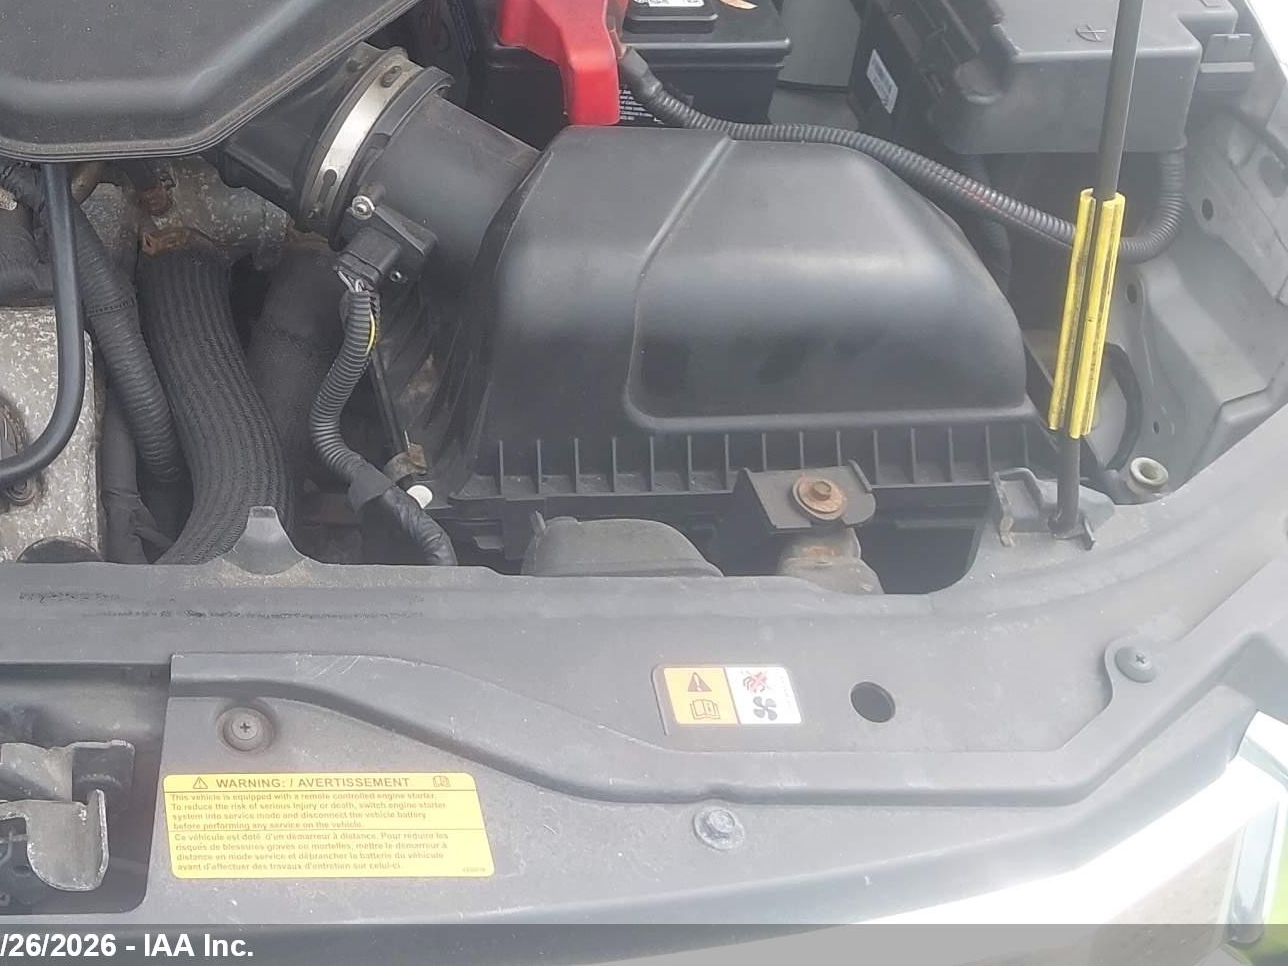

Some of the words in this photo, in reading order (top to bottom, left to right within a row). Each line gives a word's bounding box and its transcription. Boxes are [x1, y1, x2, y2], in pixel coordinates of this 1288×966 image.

[216, 778, 286, 789] WARNING:
[298, 777, 410, 788] AVERTISSEMENT
[233, 793, 271, 801] equipped
[377, 792, 405, 800] engine
[389, 802, 416, 810] engine
[172, 814, 203, 822] system
[224, 813, 254, 821] service
[301, 812, 347, 820] disconnect
[350, 812, 363, 820] the
[203, 822, 249, 831] performing
[252, 822, 267, 830] any
[316, 821, 329, 829] the
[381, 832, 402, 840] Pour
[267, 843, 295, 852] graves
[298, 843, 308, 851] ou
[255, 853, 285, 861] service
[395, 852, 406, 860] du
[178, 863, 201, 871] avant
[253, 862, 265, 870] des
[270, 862, 302, 870] travaux
[353, 862, 366, 870] sur
